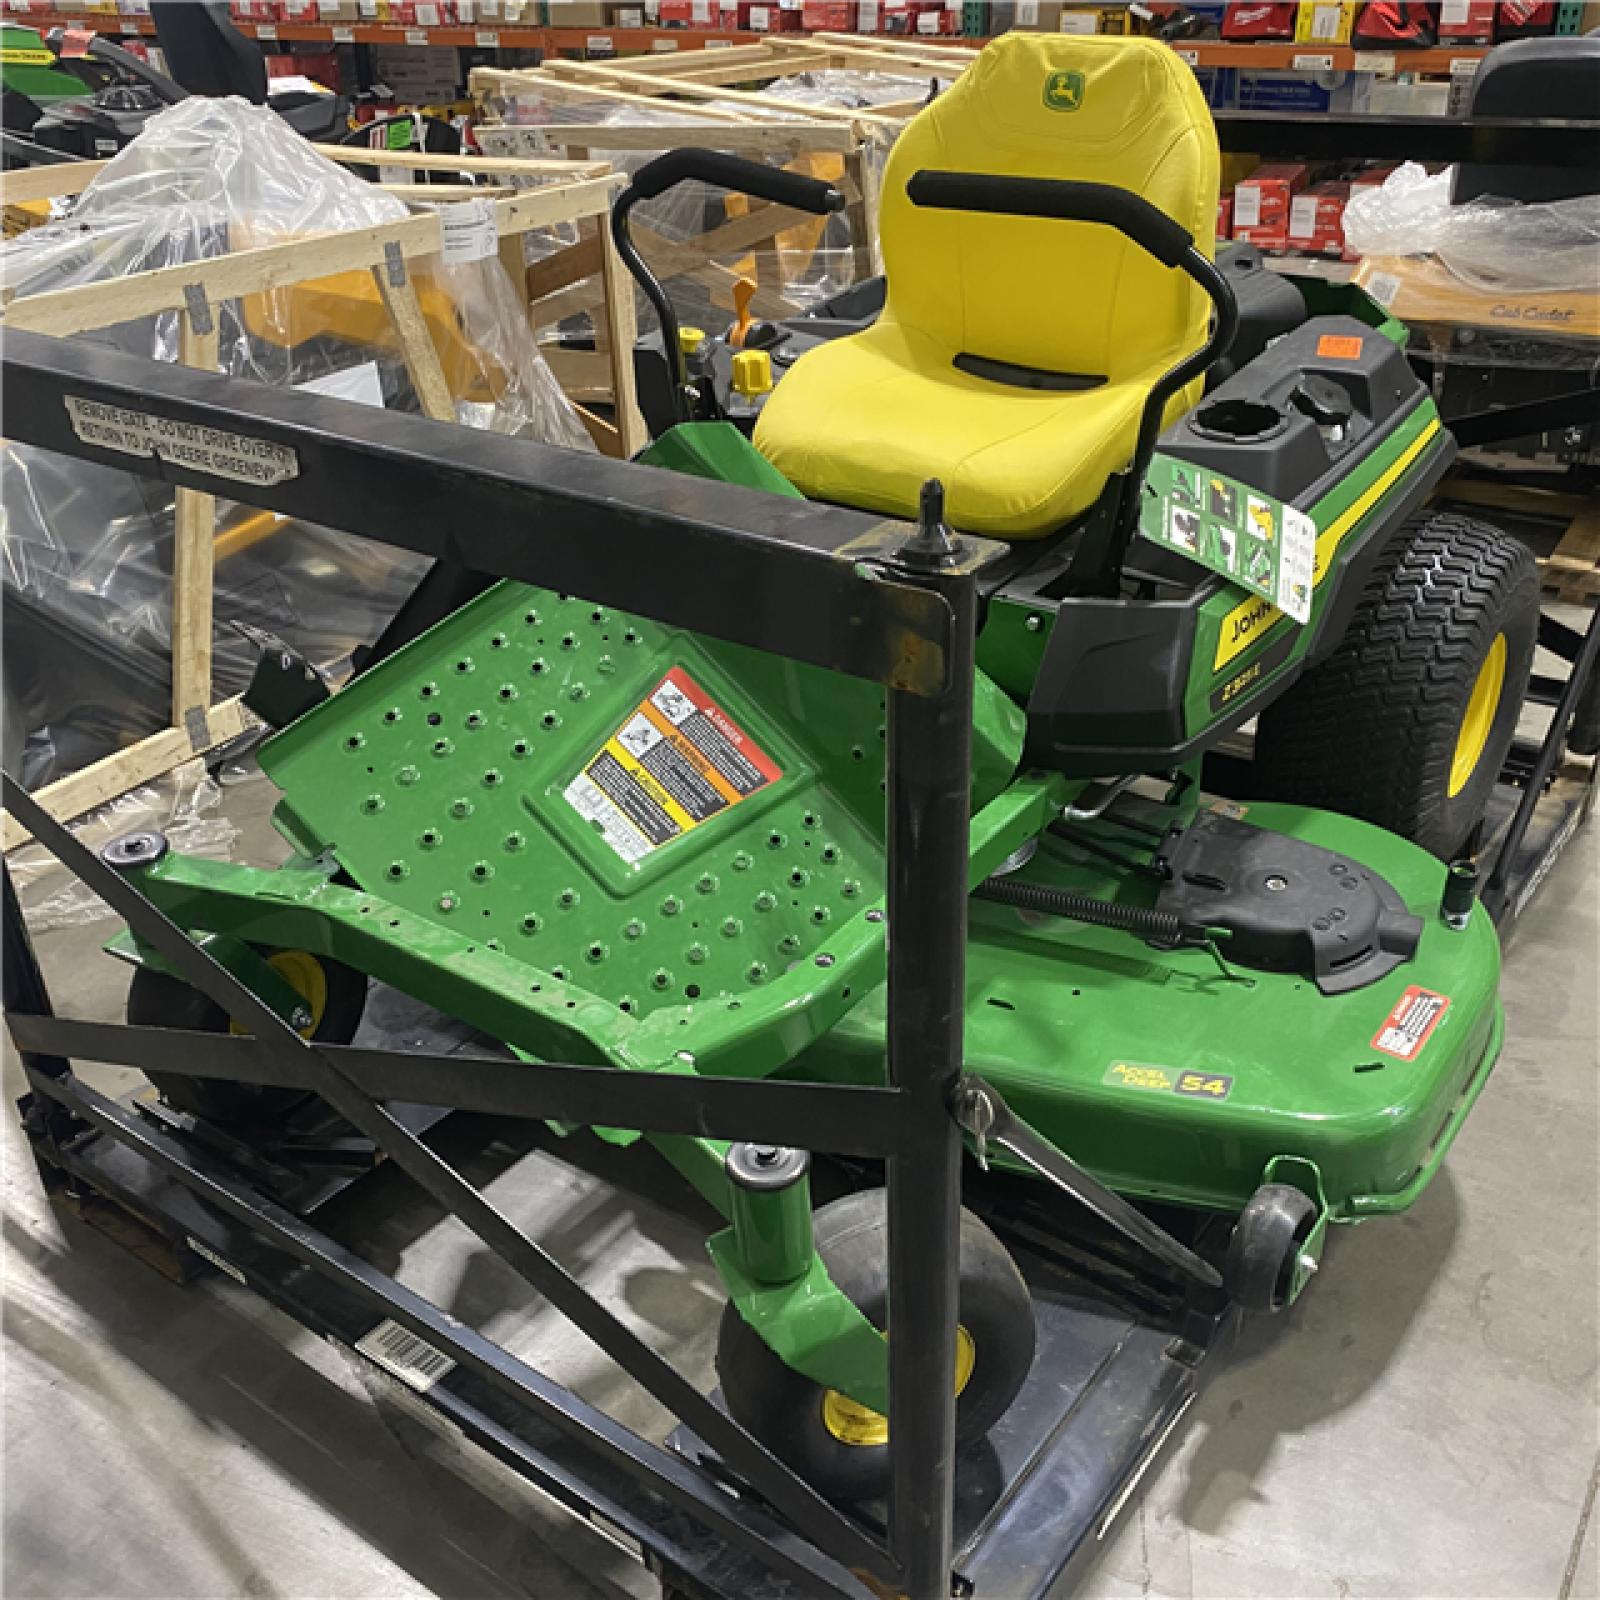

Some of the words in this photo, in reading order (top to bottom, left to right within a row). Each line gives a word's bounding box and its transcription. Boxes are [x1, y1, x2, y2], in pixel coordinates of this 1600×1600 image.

[74, 399, 121, 423] REMOVE
[177, 423, 199, 441] NOT
[202, 429, 238, 453] DRIVE
[80, 419, 122, 443] RETURN
[173, 443, 211, 466] DEERE
[1232, 601, 1272, 643] JOHN
[1181, 1074, 1227, 1097] 54
